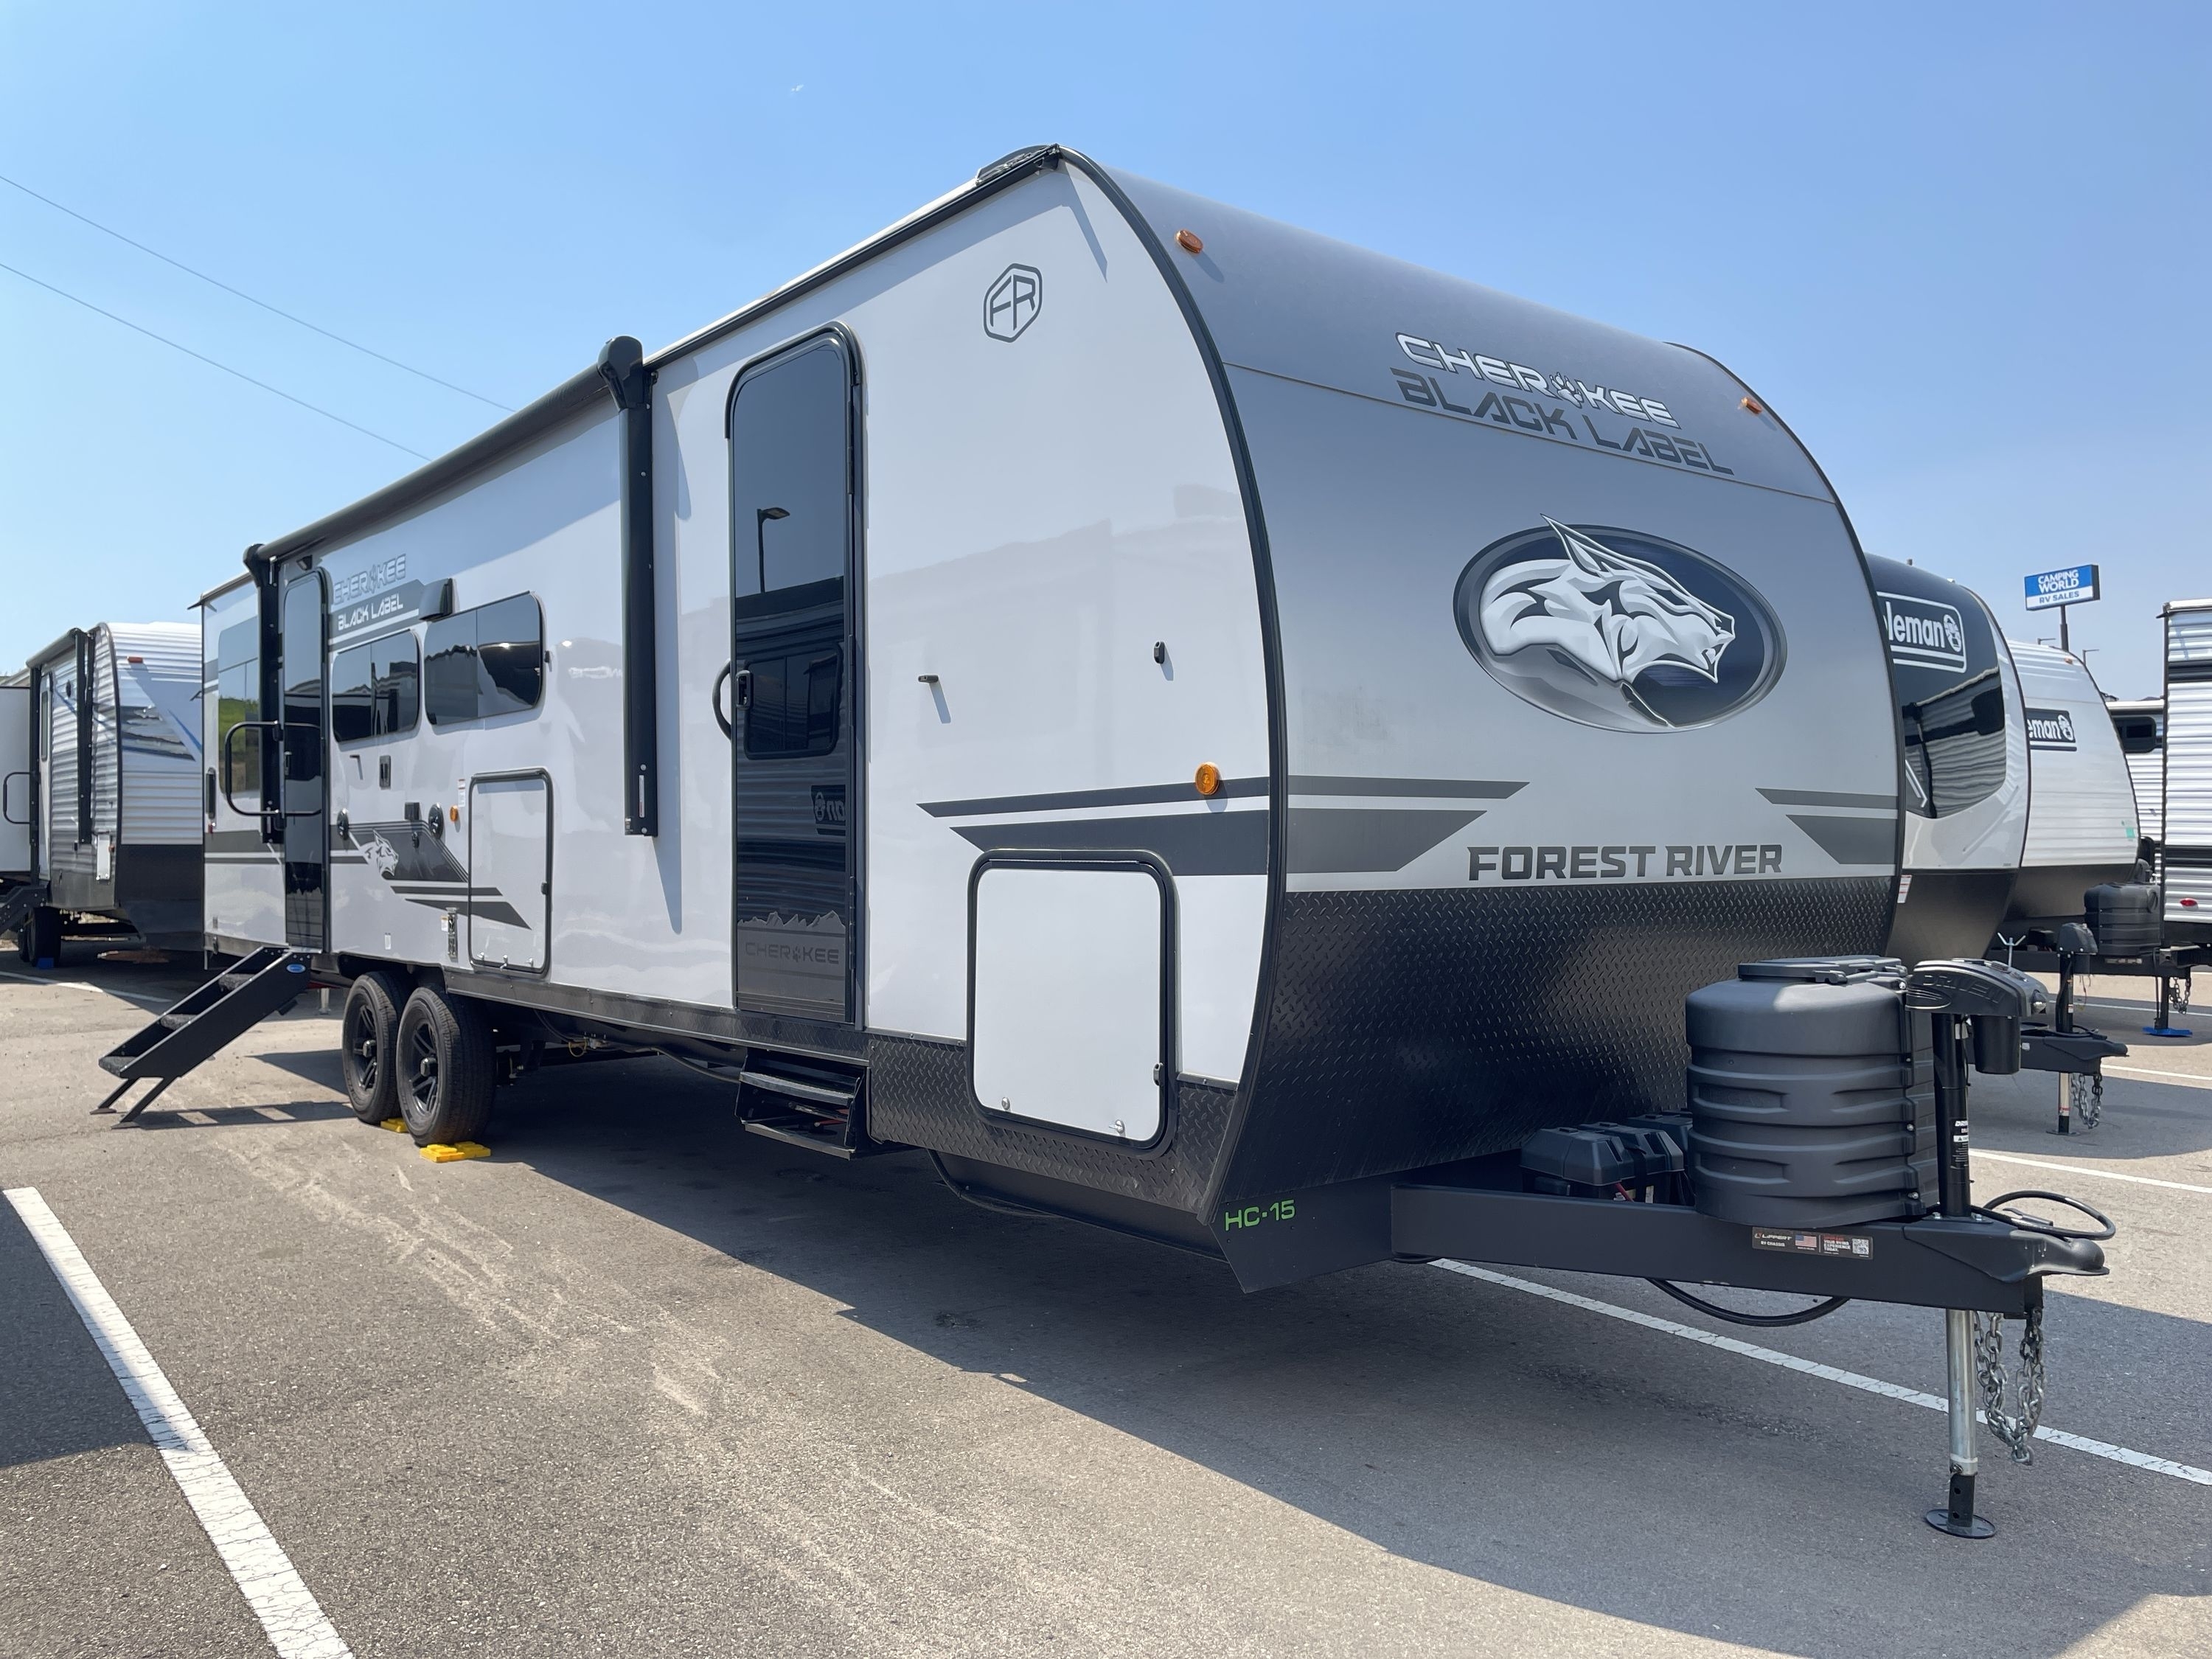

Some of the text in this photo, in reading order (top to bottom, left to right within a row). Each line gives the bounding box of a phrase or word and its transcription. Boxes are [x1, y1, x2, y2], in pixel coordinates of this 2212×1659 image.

[1390, 367, 1735, 476] BLACK LABEL
[2037, 569, 2079, 584] CAMPING
[2038, 578, 2079, 594] WORLD
[338, 593, 404, 631] BLACK LABEL
[2039, 591, 2079, 604] RV SALES
[1883, 601, 1946, 648] leman
[1467, 844, 1783, 881] FOREST RIVER
